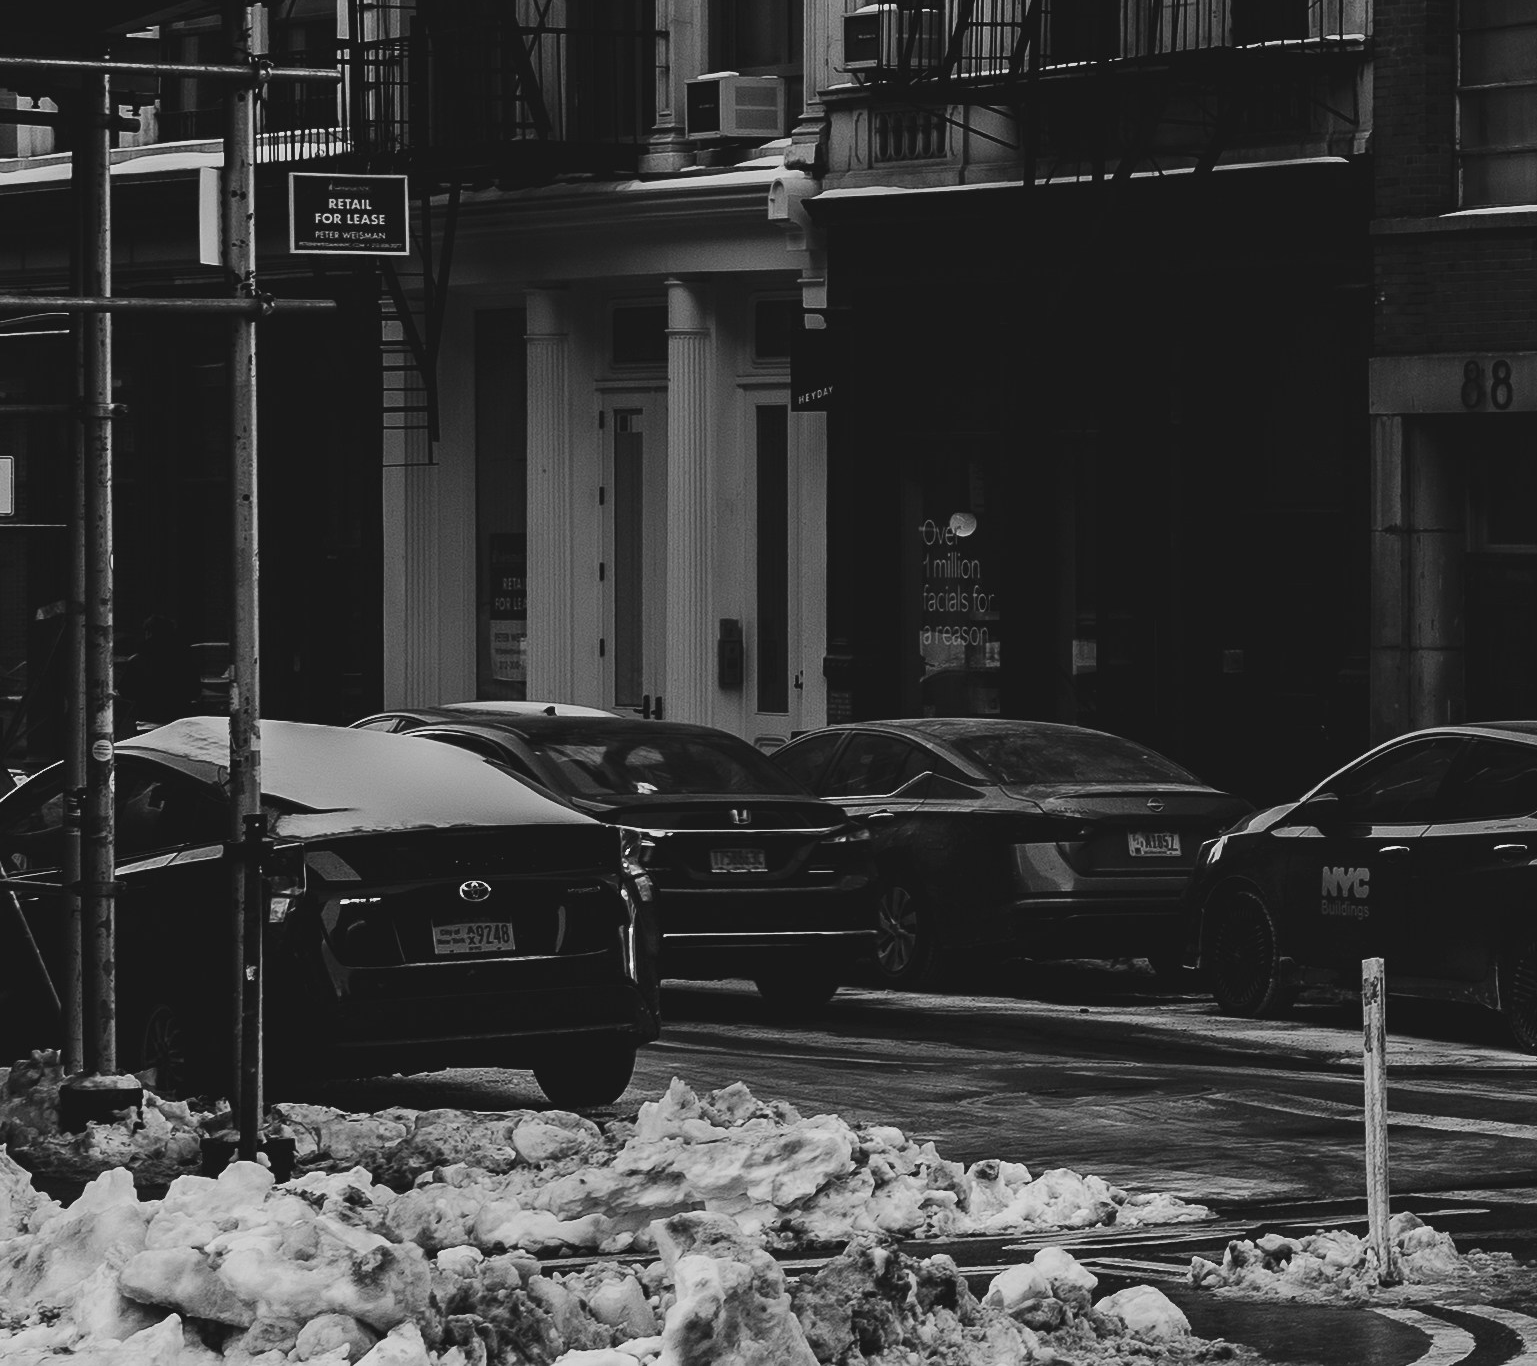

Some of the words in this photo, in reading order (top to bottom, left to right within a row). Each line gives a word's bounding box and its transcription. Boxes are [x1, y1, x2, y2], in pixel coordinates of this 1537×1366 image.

[328, 198, 372, 210] RETAIL
[315, 213, 341, 224] FOR
[347, 214, 385, 225] LEASE
[315, 230, 339, 239] PETER
[798, 385, 834, 405] HEYDAY
[1460, 359, 1513, 410] 88
[922, 519, 960, 545] Over
[923, 553, 930, 579] 1
[933, 552, 981, 579] million
[495, 597, 511, 610] FOR
[923, 584, 969, 612] facials
[972, 584, 995, 613] for
[923, 626, 932, 645] a
[935, 625, 989, 646] reason
[1322, 866, 1370, 898] NYC
[1321, 899, 1370, 920] Buildings
